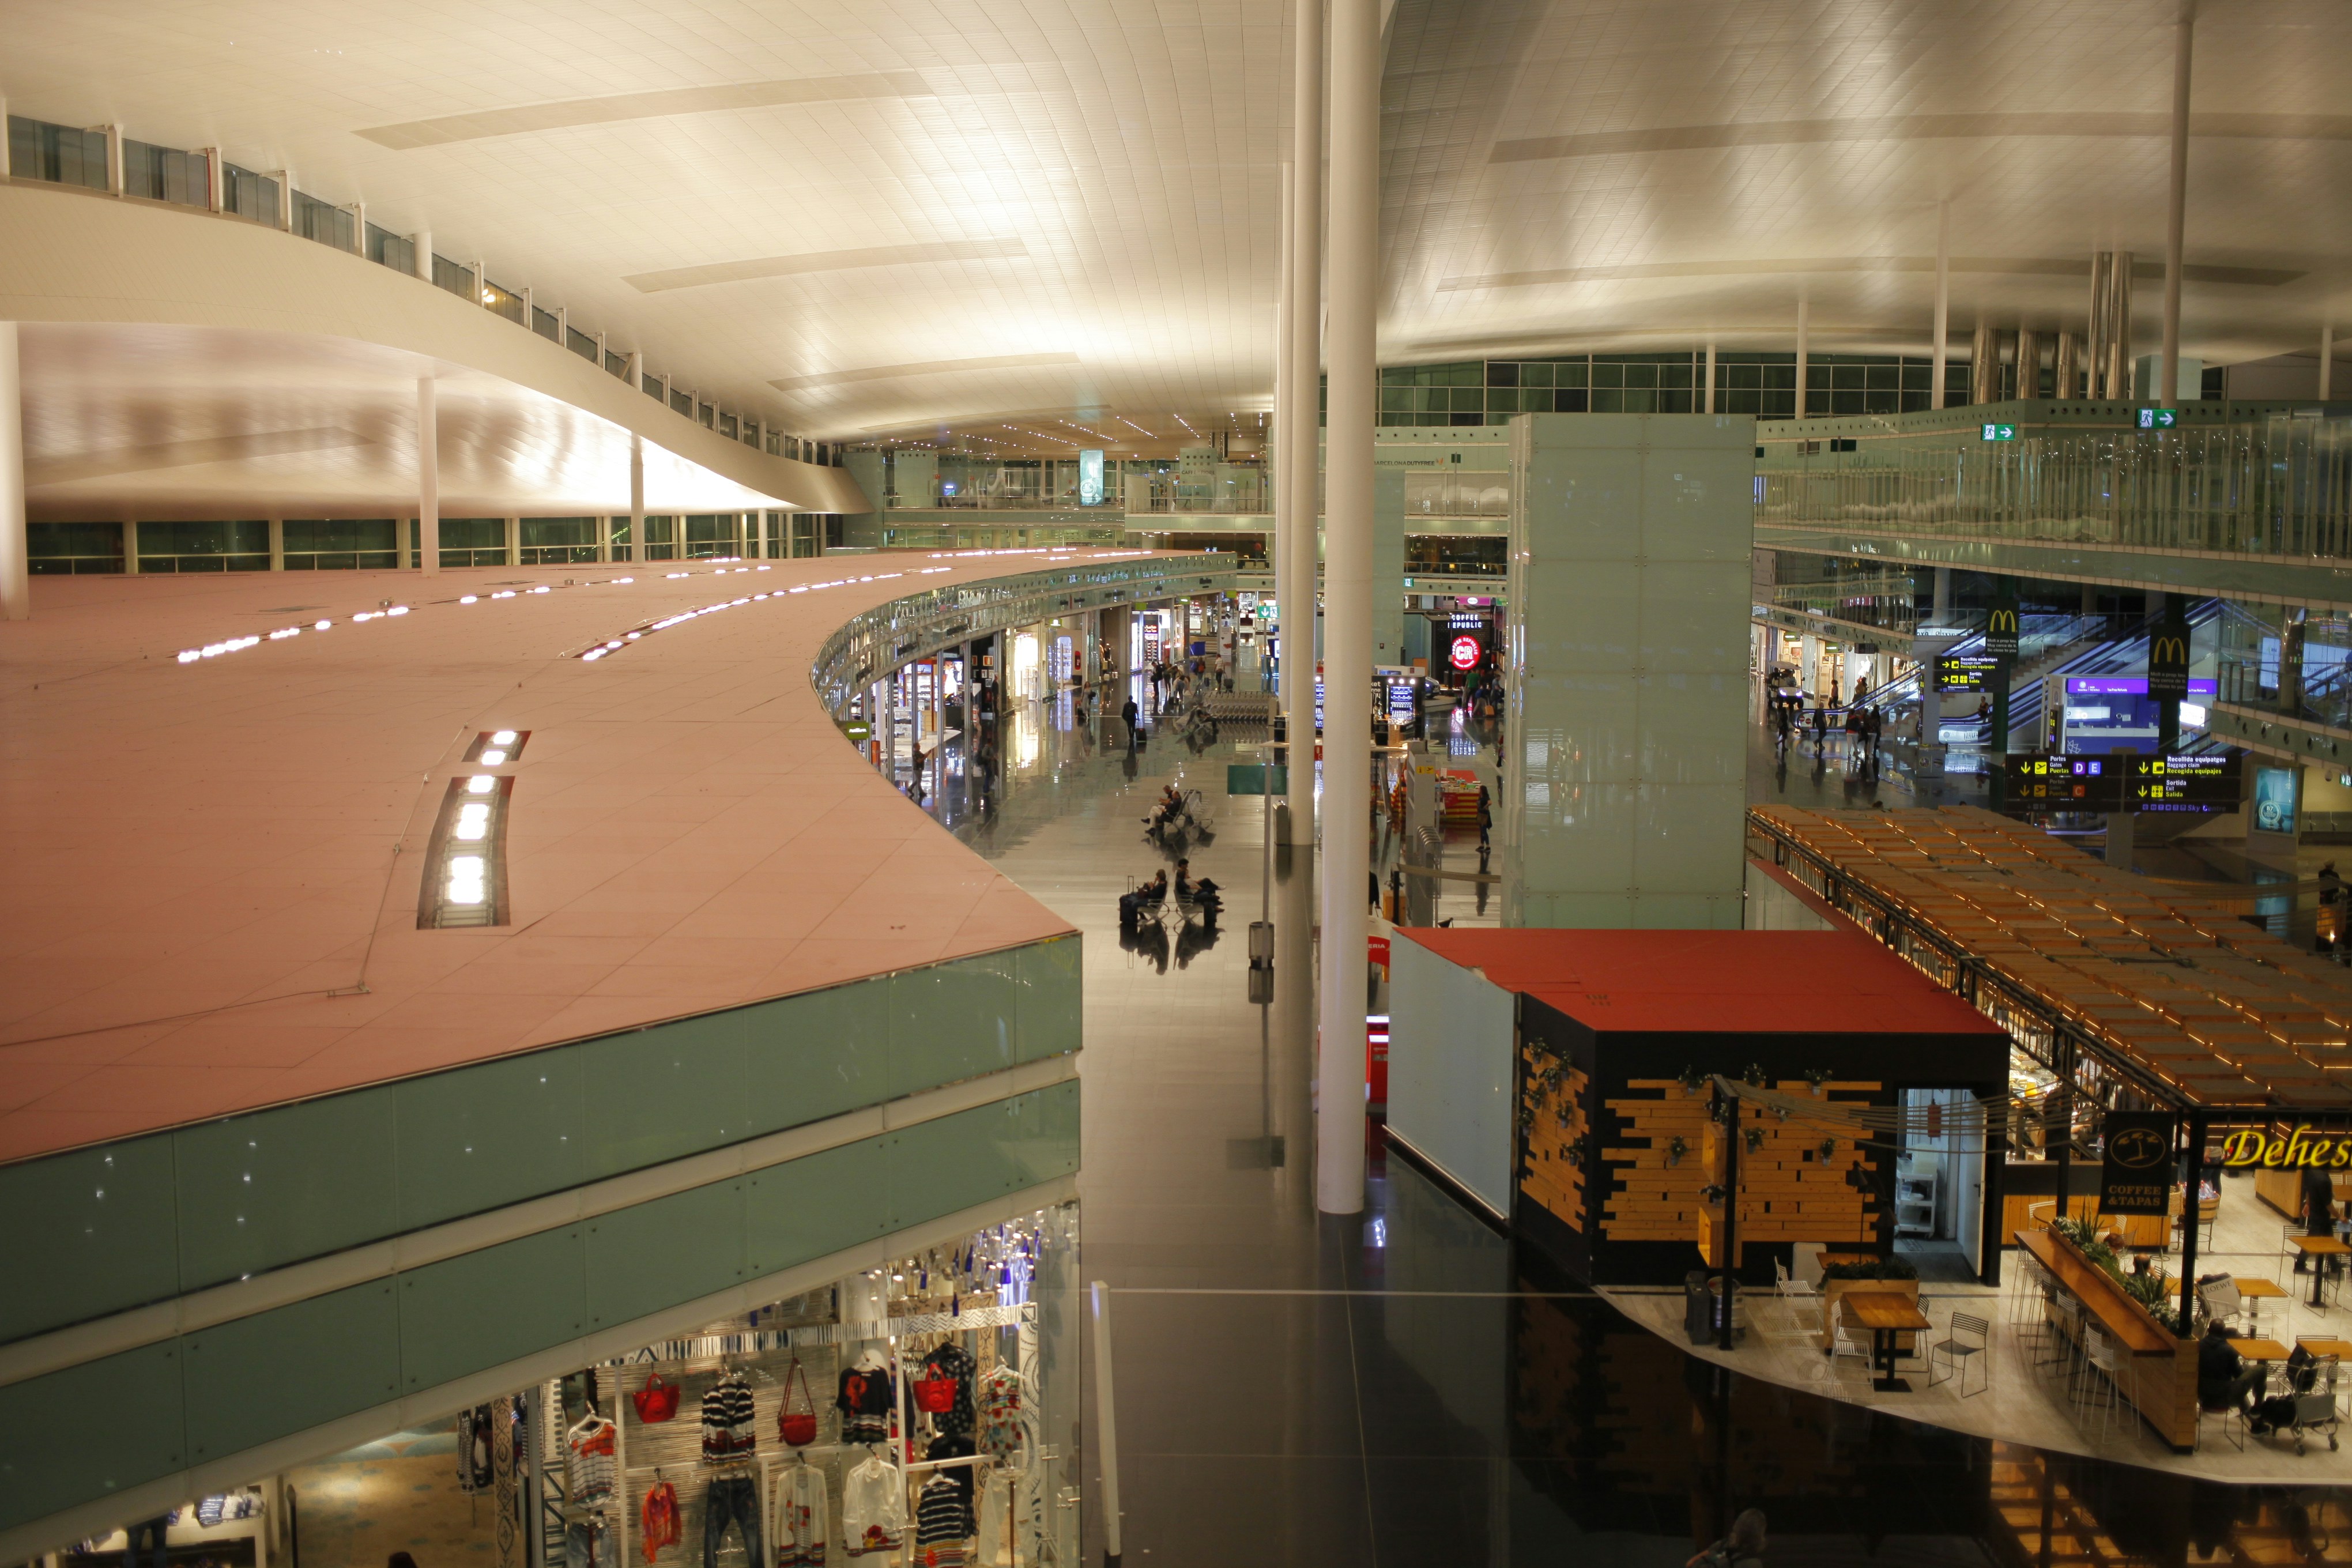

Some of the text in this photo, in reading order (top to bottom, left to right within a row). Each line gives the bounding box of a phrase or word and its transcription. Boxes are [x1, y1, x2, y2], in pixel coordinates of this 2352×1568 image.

[1785, 614, 1796, 625] MANGO
[1823, 623, 1837, 635] MANGO
[1456, 646, 1474, 660] CR
[2076, 763, 2098, 772] D E
[2075, 786, 2082, 796] C
[2223, 1124, 2352, 1167] Dehes
[2108, 1185, 2161, 1195] COFFEE
[2108, 1196, 2161, 1206] &TAPAS
[2206, 1280, 2232, 1294] LOEWE
